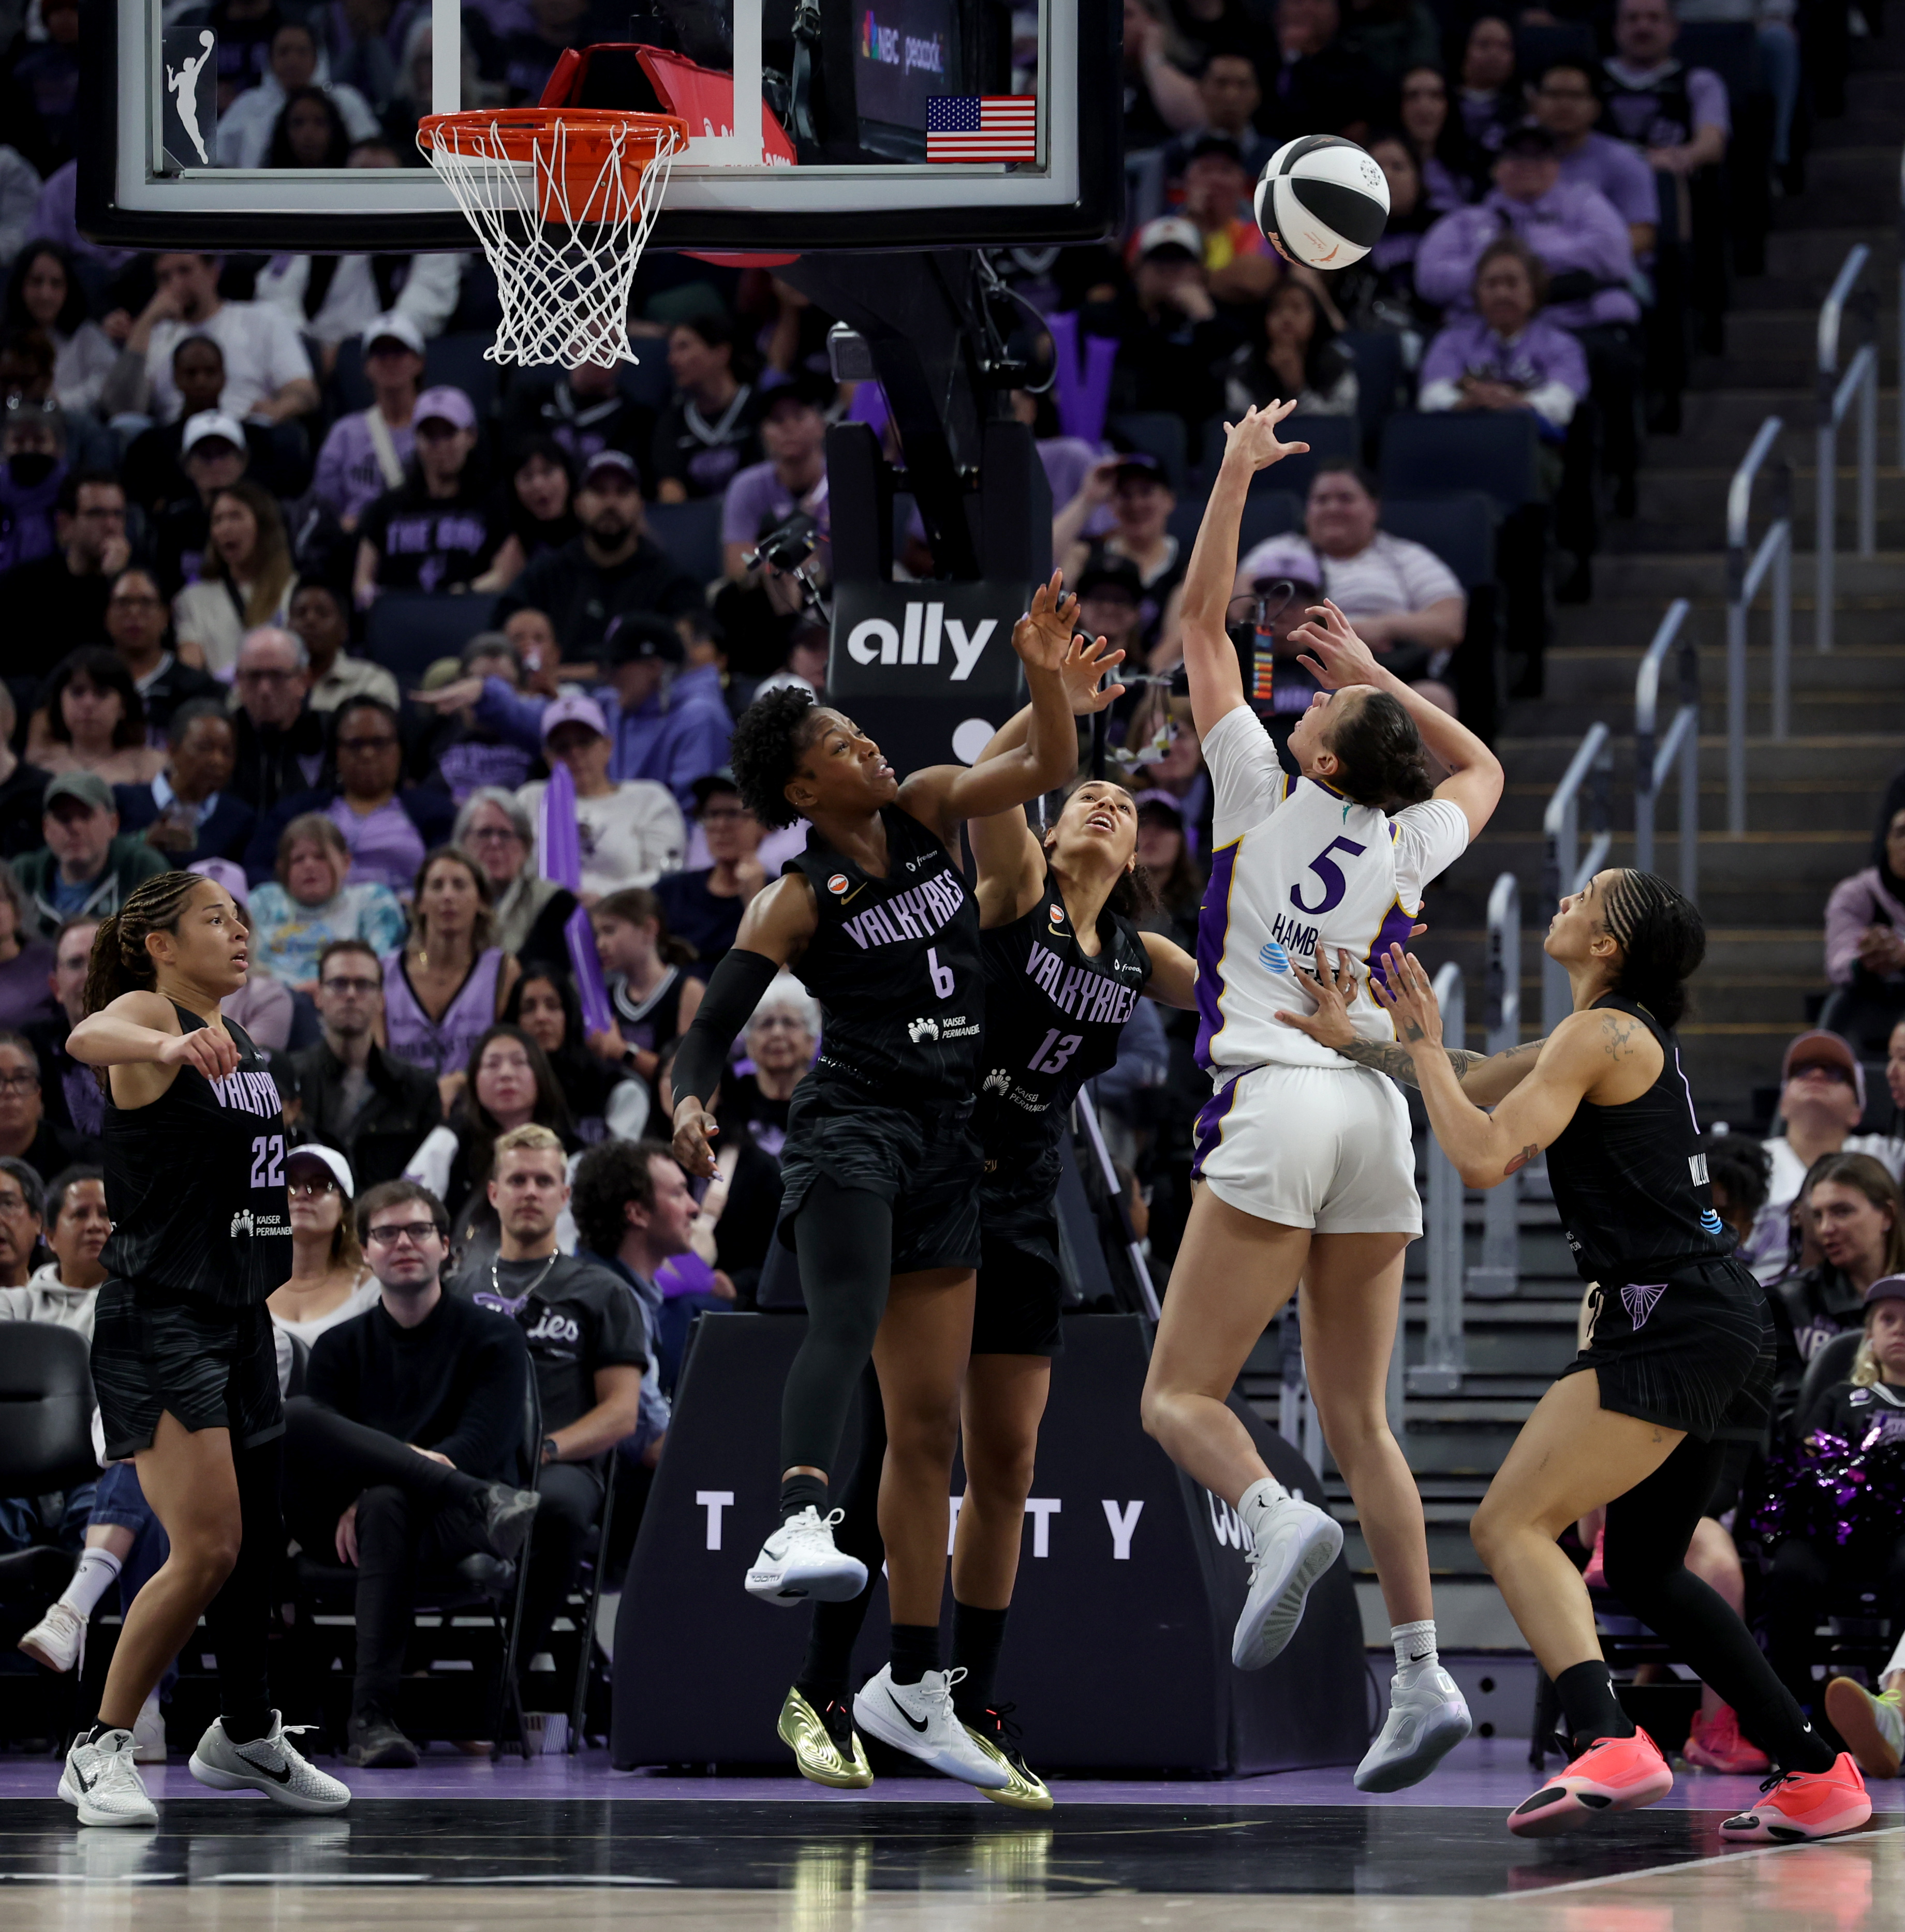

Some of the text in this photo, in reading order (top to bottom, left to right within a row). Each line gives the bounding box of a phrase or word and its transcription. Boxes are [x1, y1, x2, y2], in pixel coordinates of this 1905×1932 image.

[847, 601, 998, 681] ally
[1290, 835, 1367, 914] 5
[841, 869, 964, 949] VALKYRIES
[1272, 913, 1318, 956] HAMB
[926, 947, 955, 999] 6
[1025, 940, 1136, 1023] VALKYRIES
[1121, 963, 1142, 974] freedo
[942, 1016, 966, 1028] KAISER
[1027, 1028, 1083, 1074] 13
[209, 1072, 282, 1119] VALKYRI
[250, 1135, 285, 1188] 22
[256, 1226, 292, 1237] PERMANEN
[257, 1215, 280, 1225] KAISER
